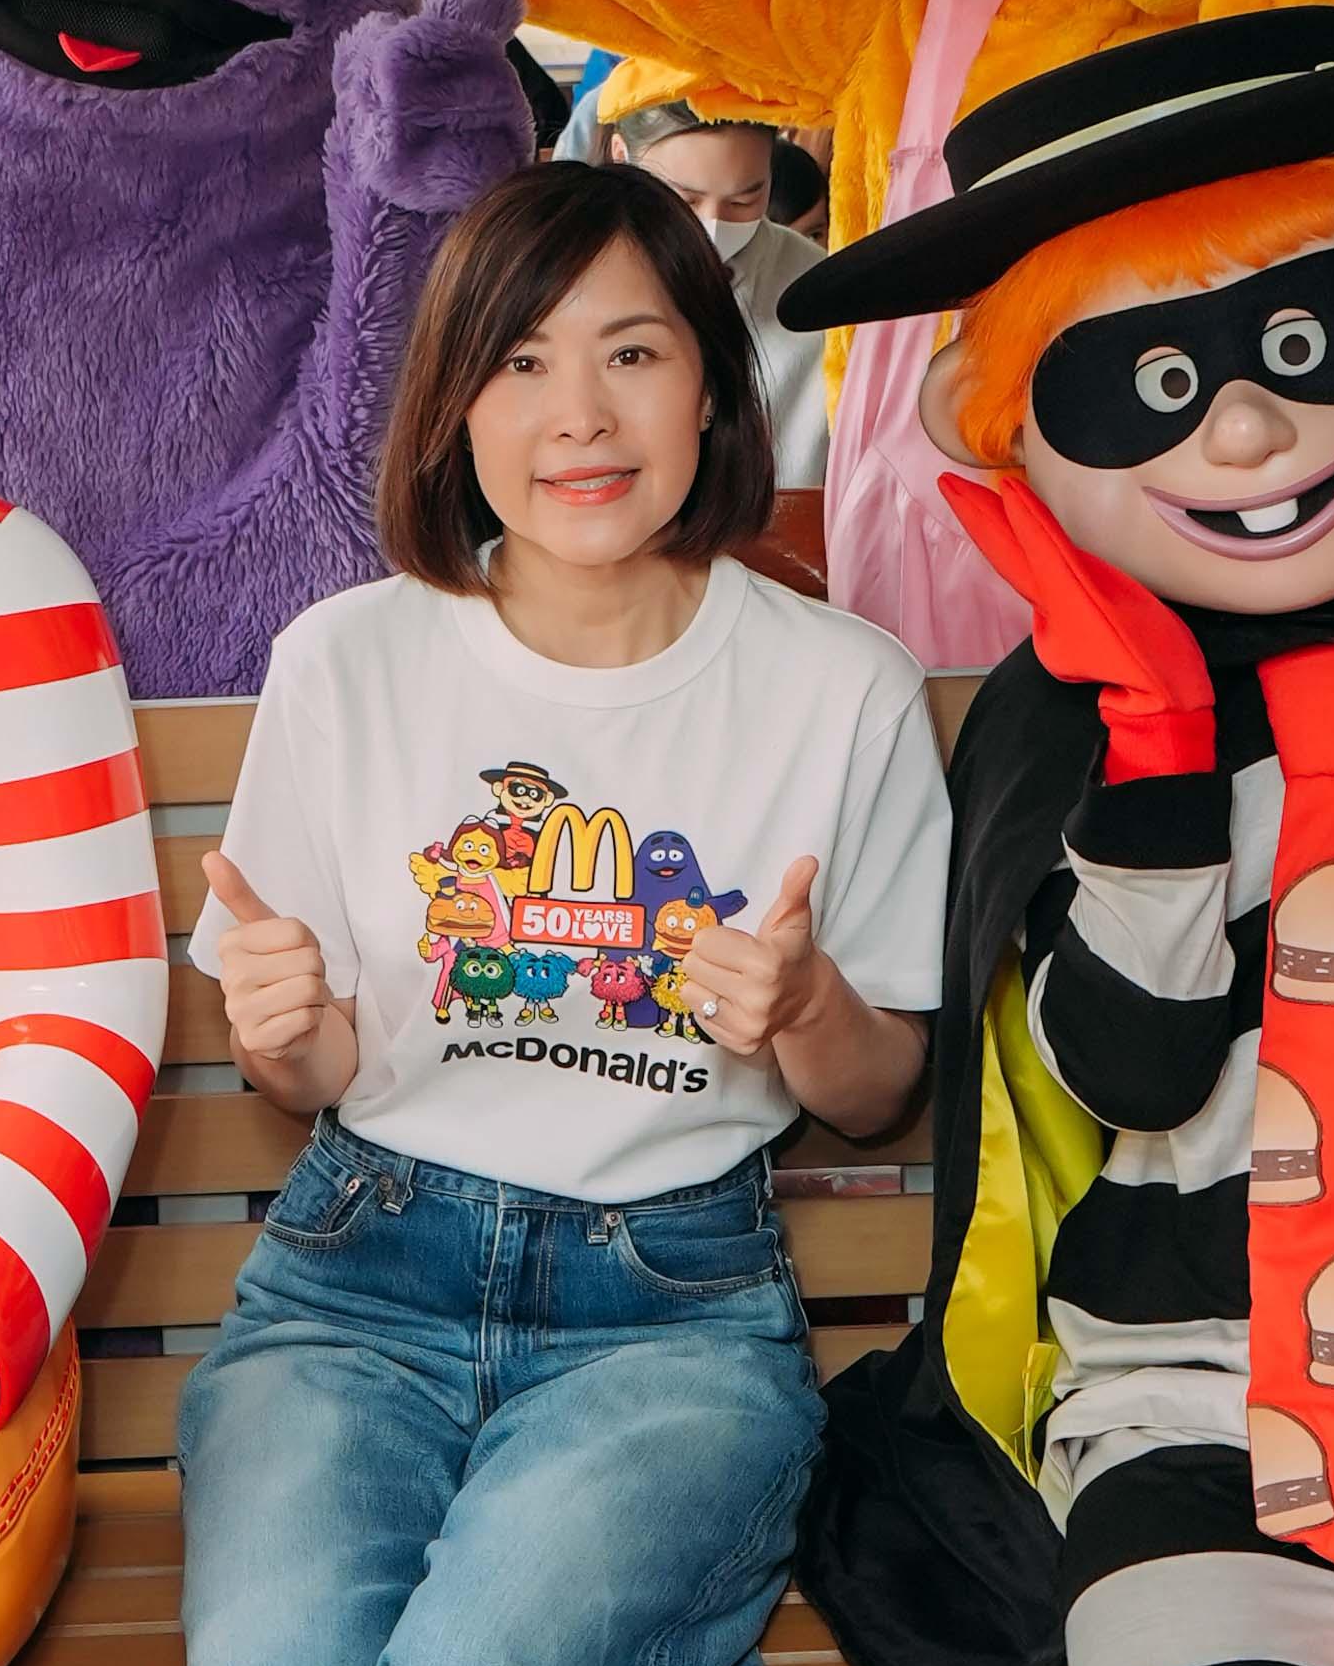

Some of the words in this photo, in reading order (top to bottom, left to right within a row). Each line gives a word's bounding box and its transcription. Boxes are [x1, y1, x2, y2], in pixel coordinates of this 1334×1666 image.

[521, 905, 572, 938] 50
[573, 908, 625, 924] YEARS
[440, 1036, 710, 1094] McDonald's
